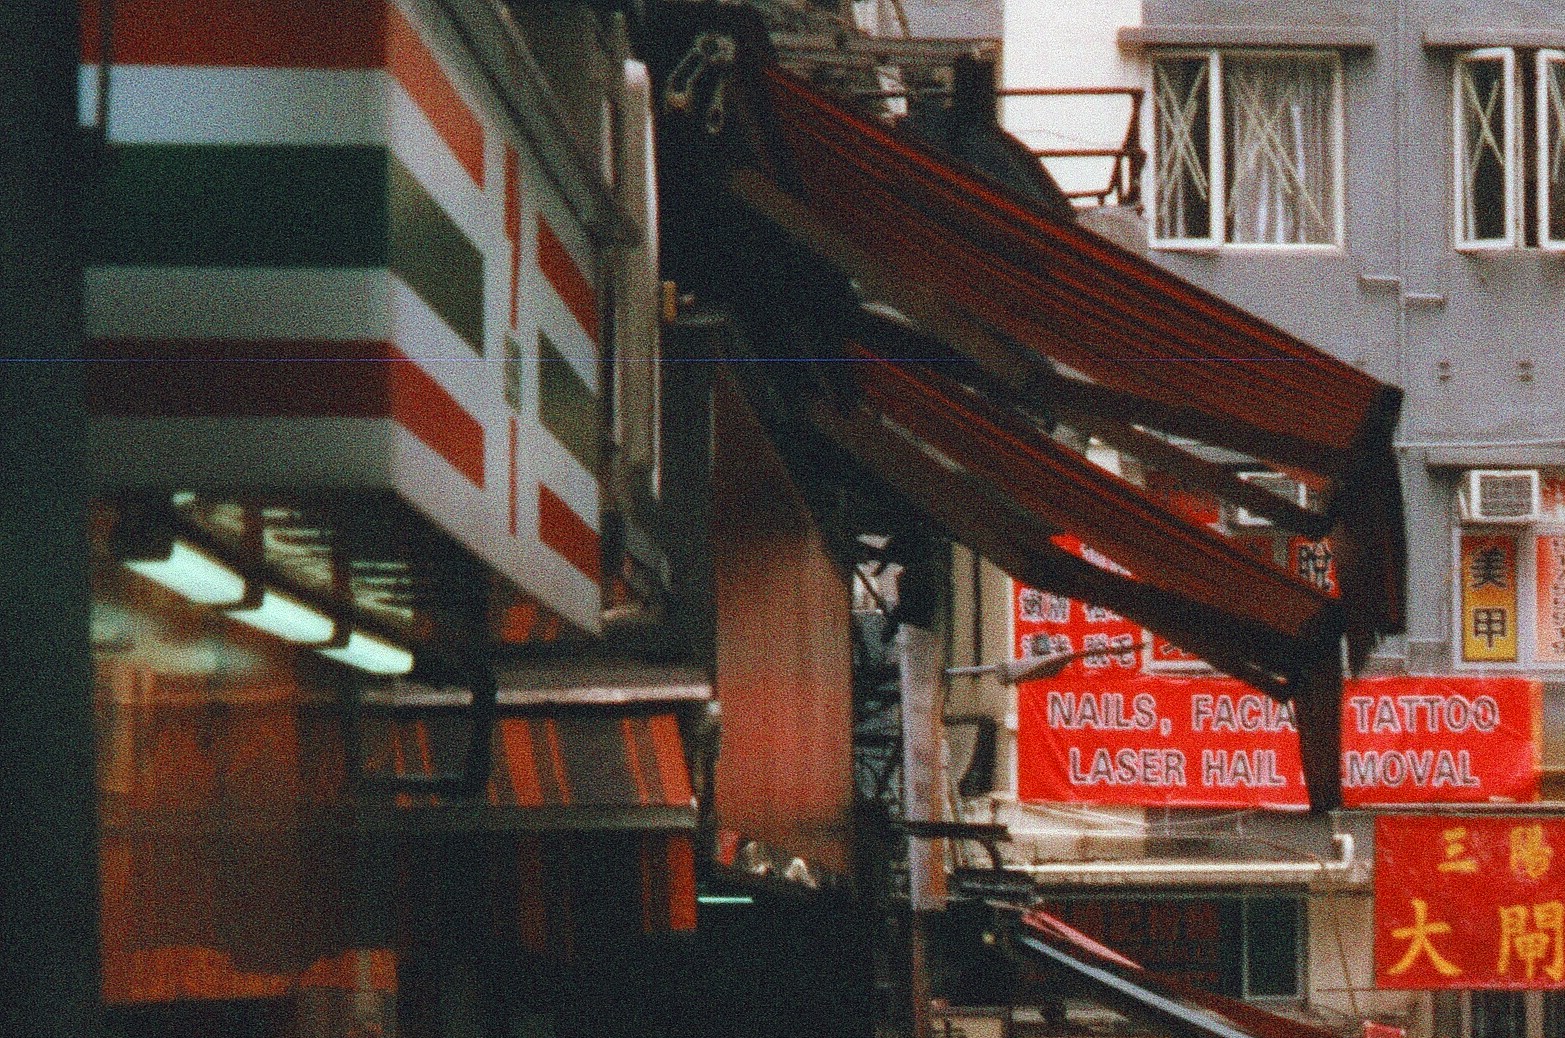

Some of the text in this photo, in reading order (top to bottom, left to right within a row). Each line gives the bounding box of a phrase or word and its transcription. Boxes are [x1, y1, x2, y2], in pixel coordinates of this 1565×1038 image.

[1469, 543, 1510, 651] 美甲
[1047, 691, 1499, 736] NAILS, FACIA TATTOO
[1069, 747, 1186, 786] LASER
[1202, 749, 1286, 786] HAIL
